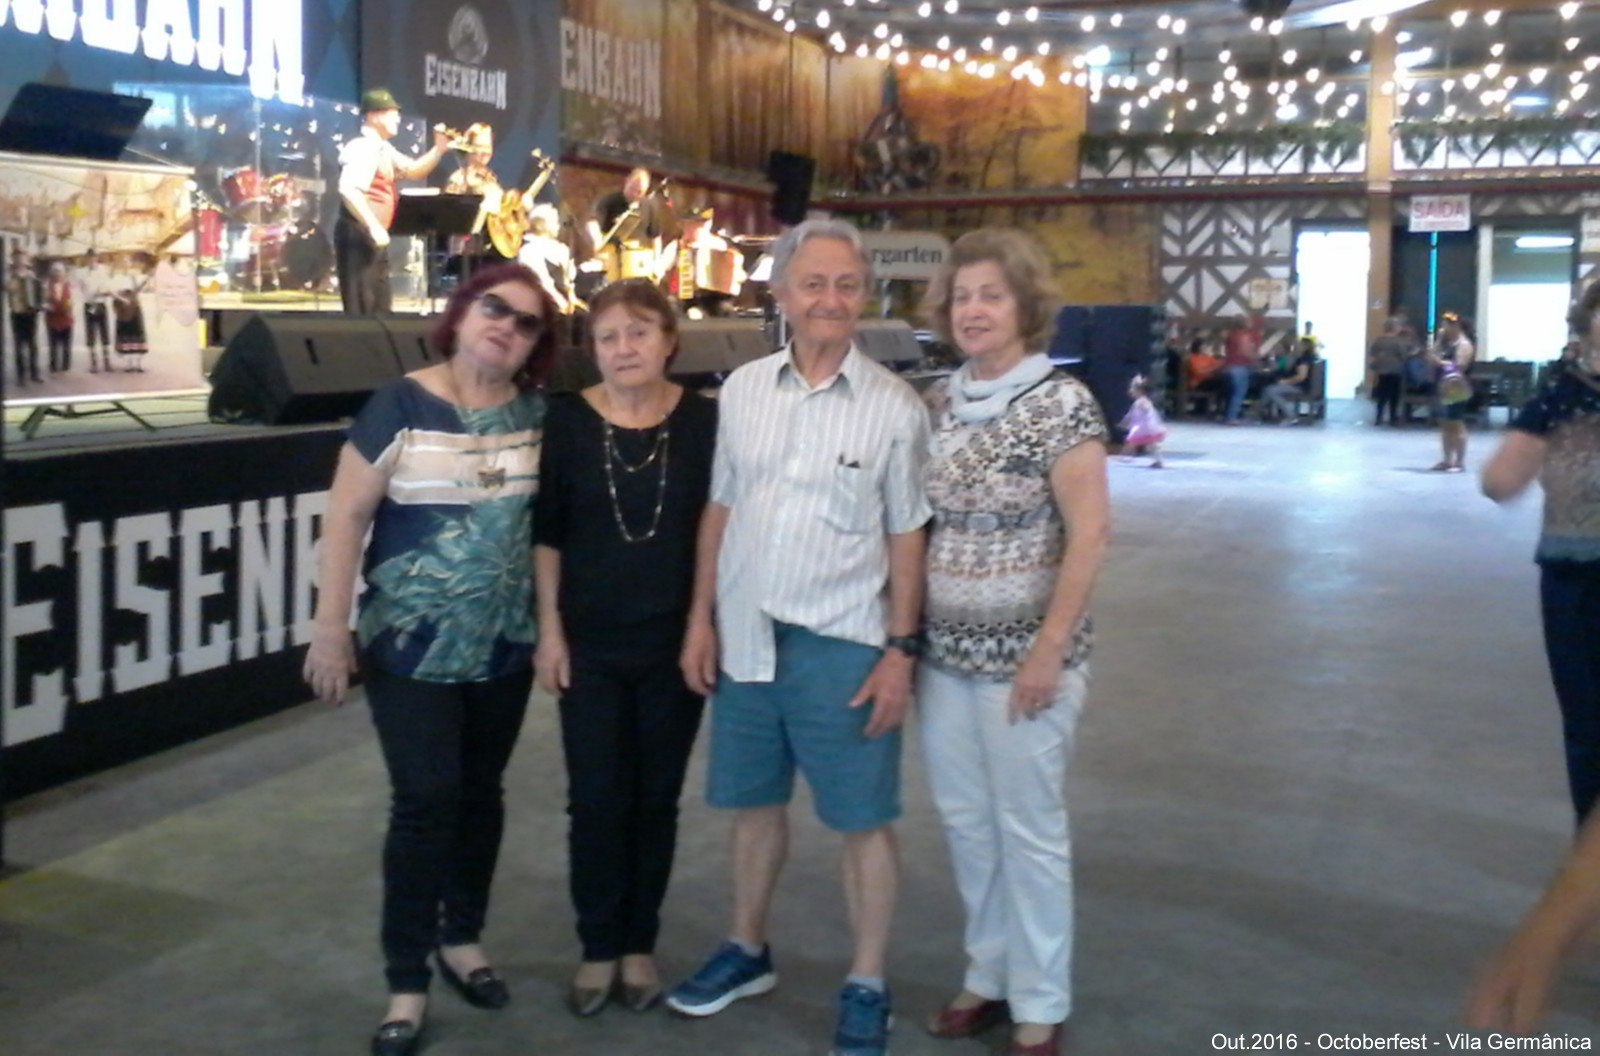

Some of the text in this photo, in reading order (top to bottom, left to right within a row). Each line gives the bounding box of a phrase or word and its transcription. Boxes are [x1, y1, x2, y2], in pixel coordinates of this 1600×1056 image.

[425, 53, 507, 110] EISENBAHN
[560, 18, 661, 119] ENBAHN
[871, 246, 942, 265] rgarten
[1, 488, 372, 747] EISENB
